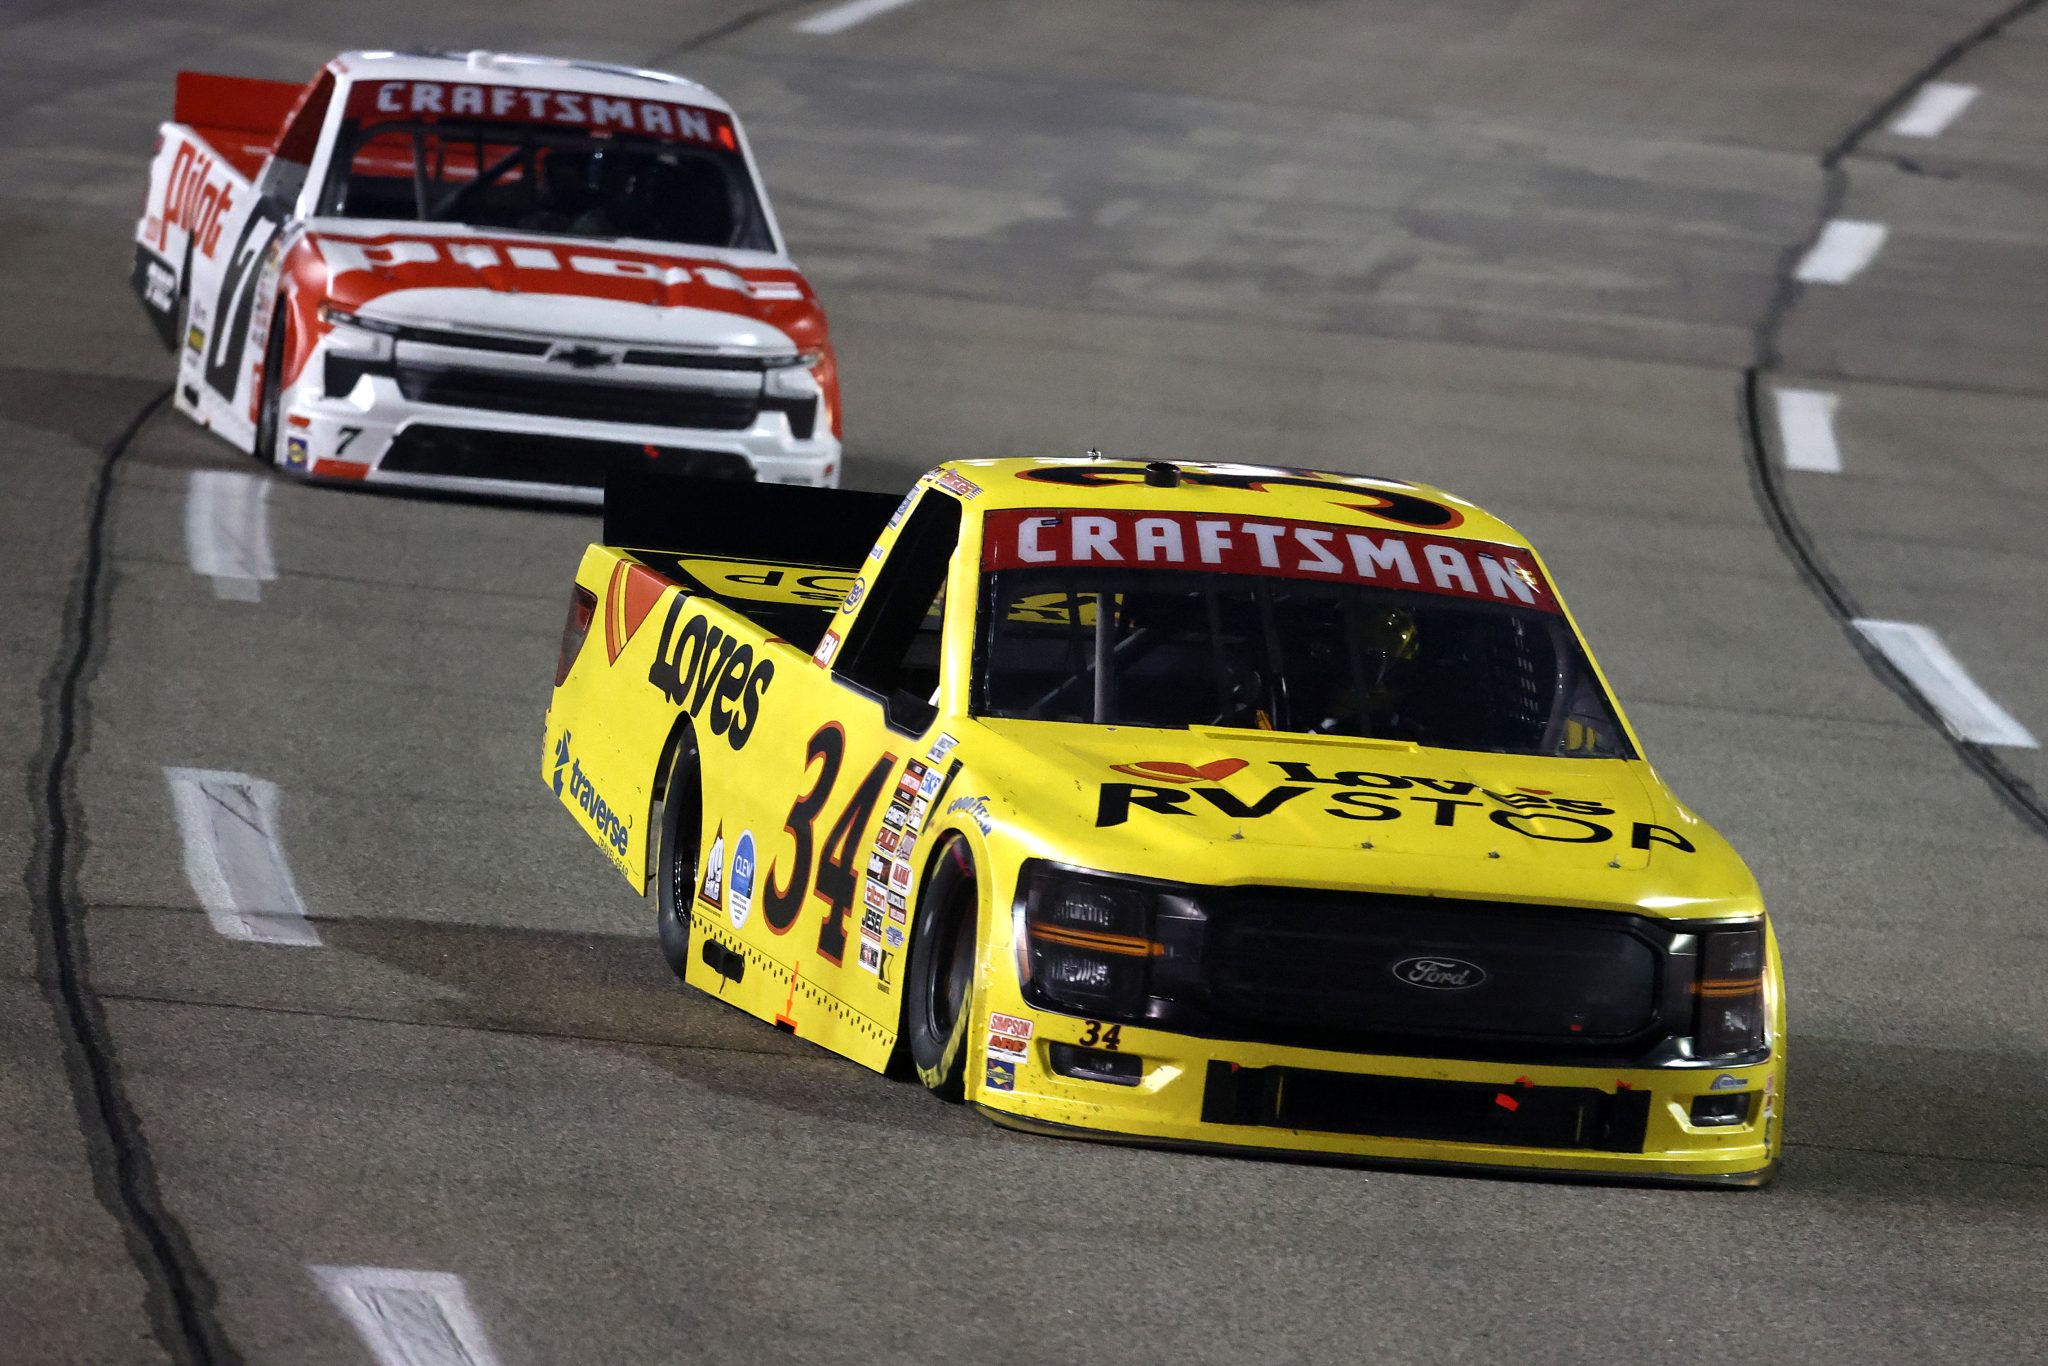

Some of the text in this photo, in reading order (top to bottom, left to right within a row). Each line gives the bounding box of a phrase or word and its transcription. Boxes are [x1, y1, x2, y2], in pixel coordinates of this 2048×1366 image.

[376, 82, 713, 143] CRAFTSMAN
[204, 192, 292, 404] 7
[336, 425, 363, 456] 7
[1016, 515, 1536, 606] CRAFTSMAN
[569, 757, 629, 857] traverse
[920, 770, 942, 795] SKF
[763, 720, 899, 969] 34
[1095, 782, 1697, 854] RV STOP
[1408, 960, 1470, 985] Ford
[990, 1013, 1031, 1038] SIMPSON
[1079, 1020, 1122, 1051] 34
